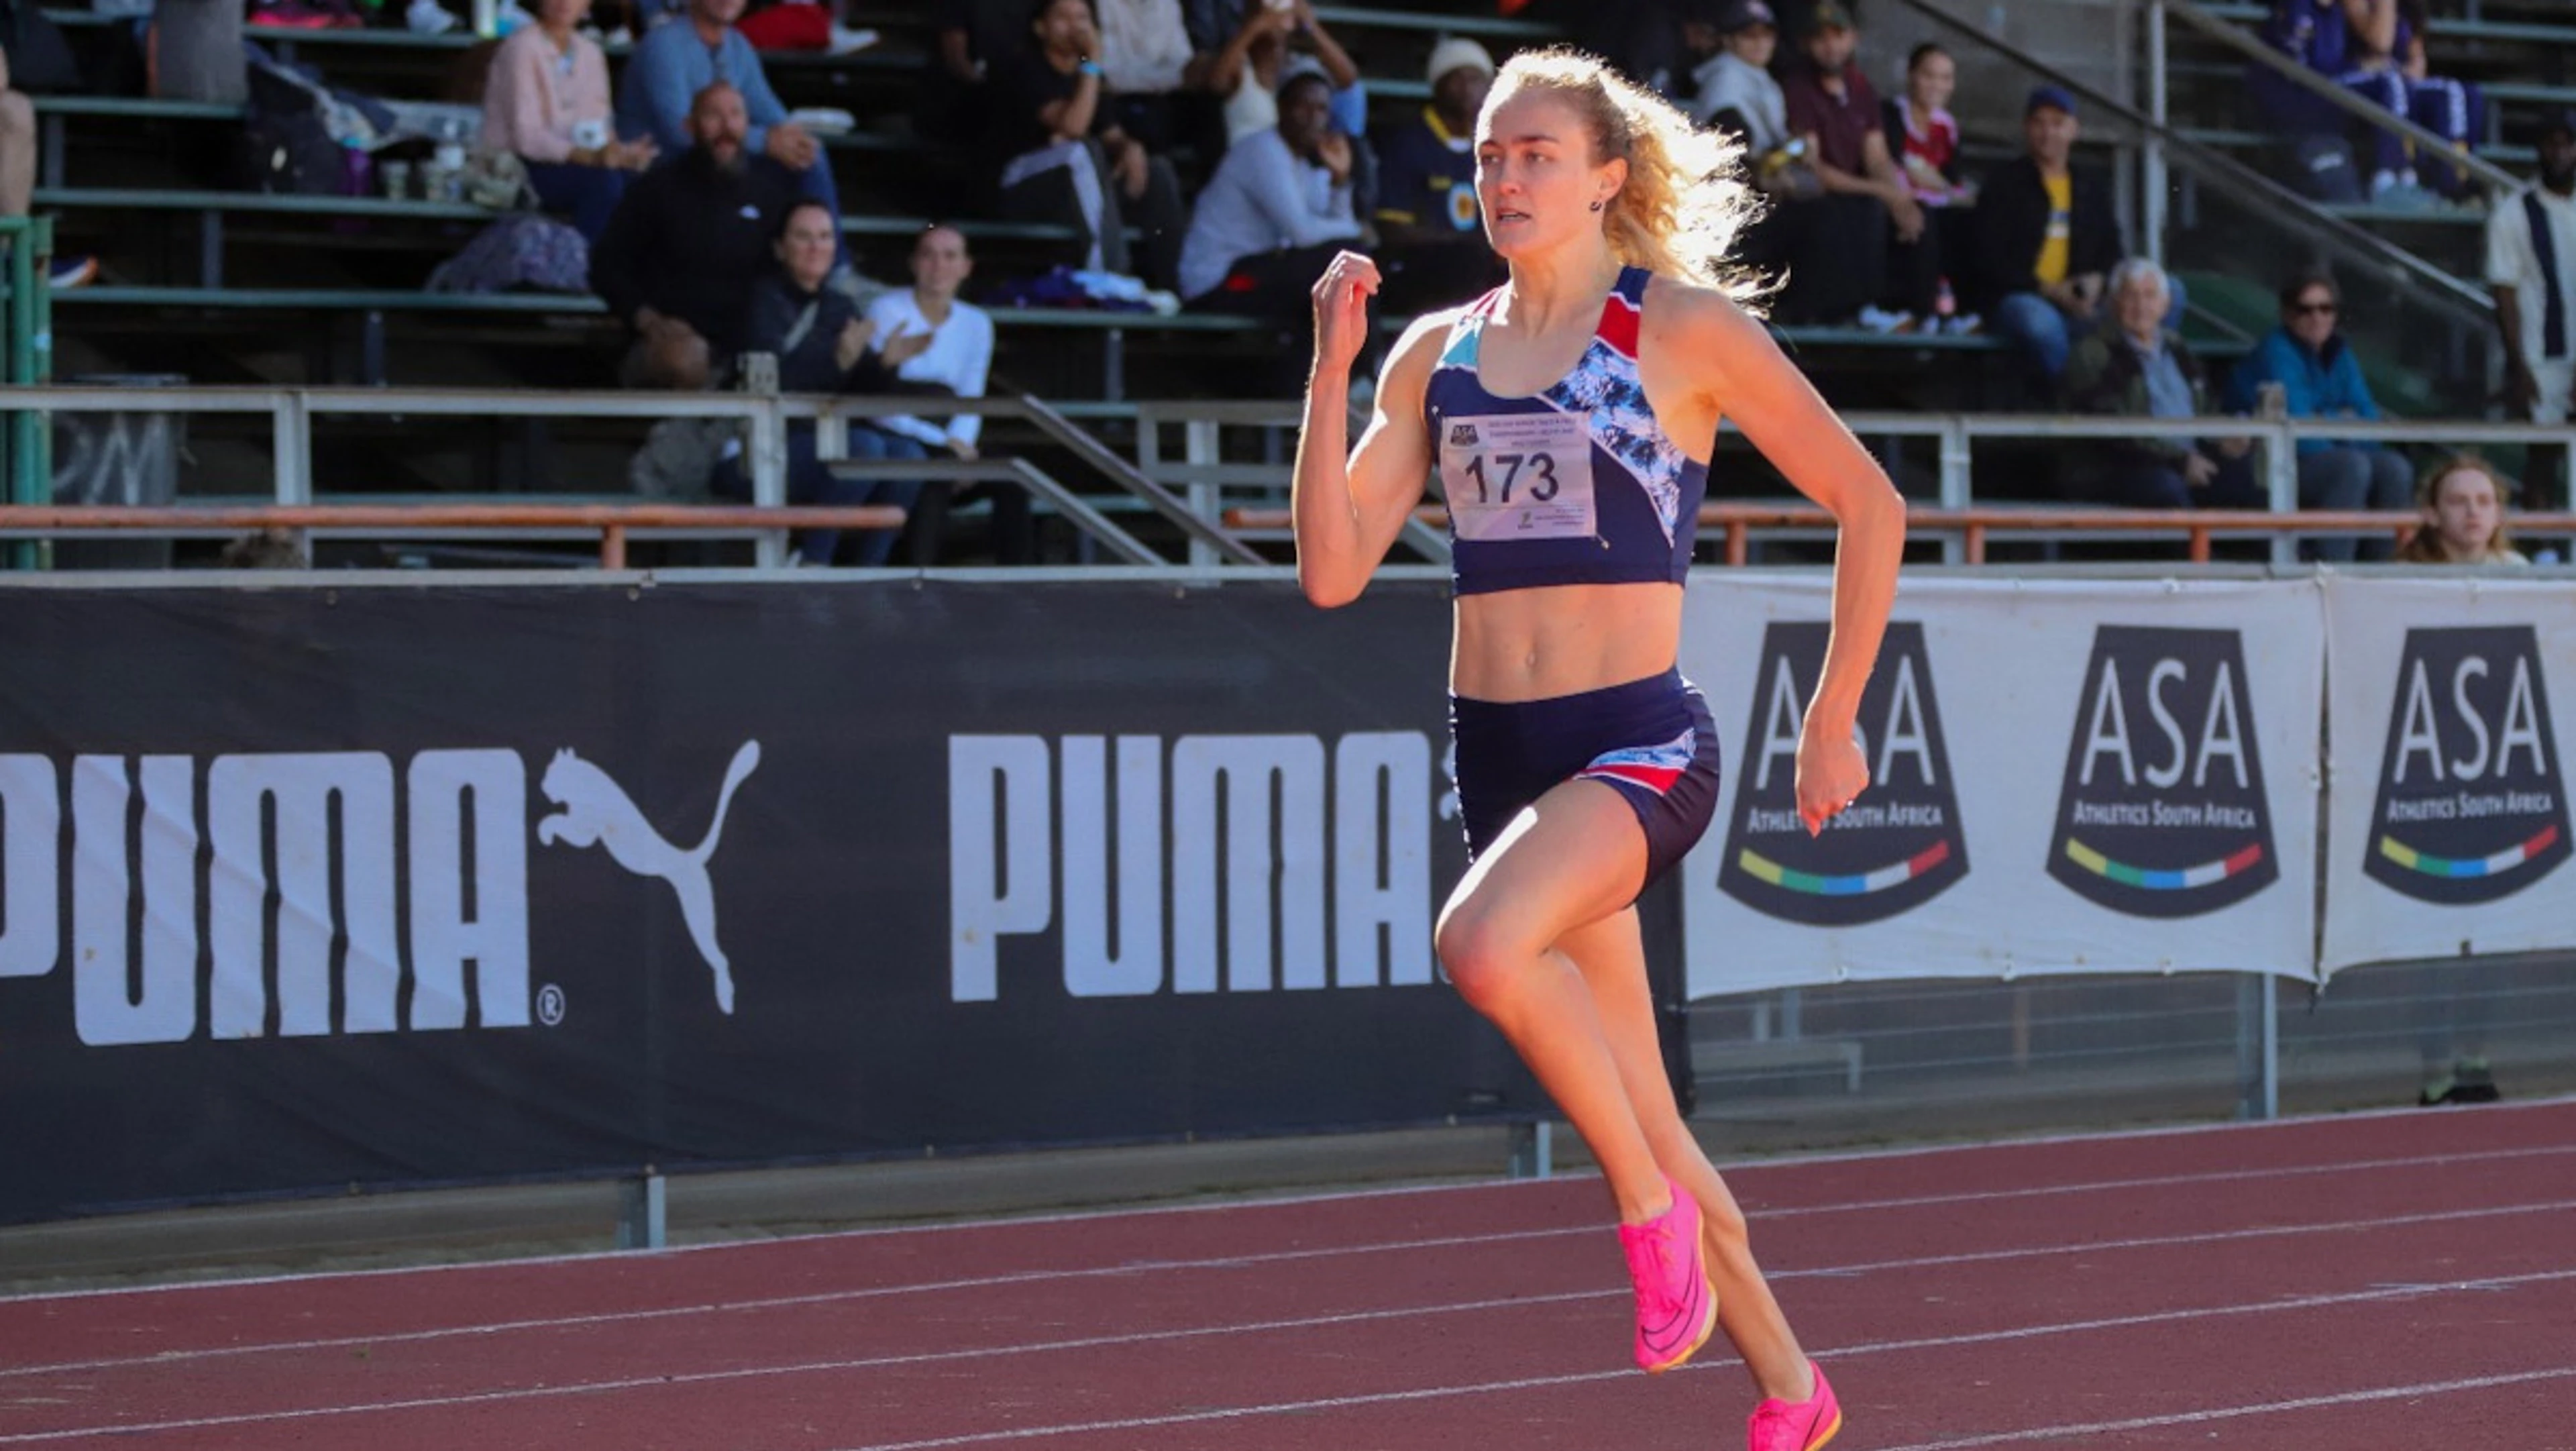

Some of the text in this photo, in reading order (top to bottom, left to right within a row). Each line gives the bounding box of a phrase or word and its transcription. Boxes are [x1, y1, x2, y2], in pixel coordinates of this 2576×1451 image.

[1465, 453, 1559, 503] 173
[1755, 653, 1935, 790] AA
[2079, 657, 2249, 788] ASA
[2394, 653, 2546, 784] ASA
[1888, 801, 1943, 827] AFRICA
[2074, 799, 2255, 828] ATHLETICS SOUTH AFRICA
[2387, 790, 2553, 823] ATHLETICS SOUTH AFRICA
[949, 731, 1433, 1002] PUMA
